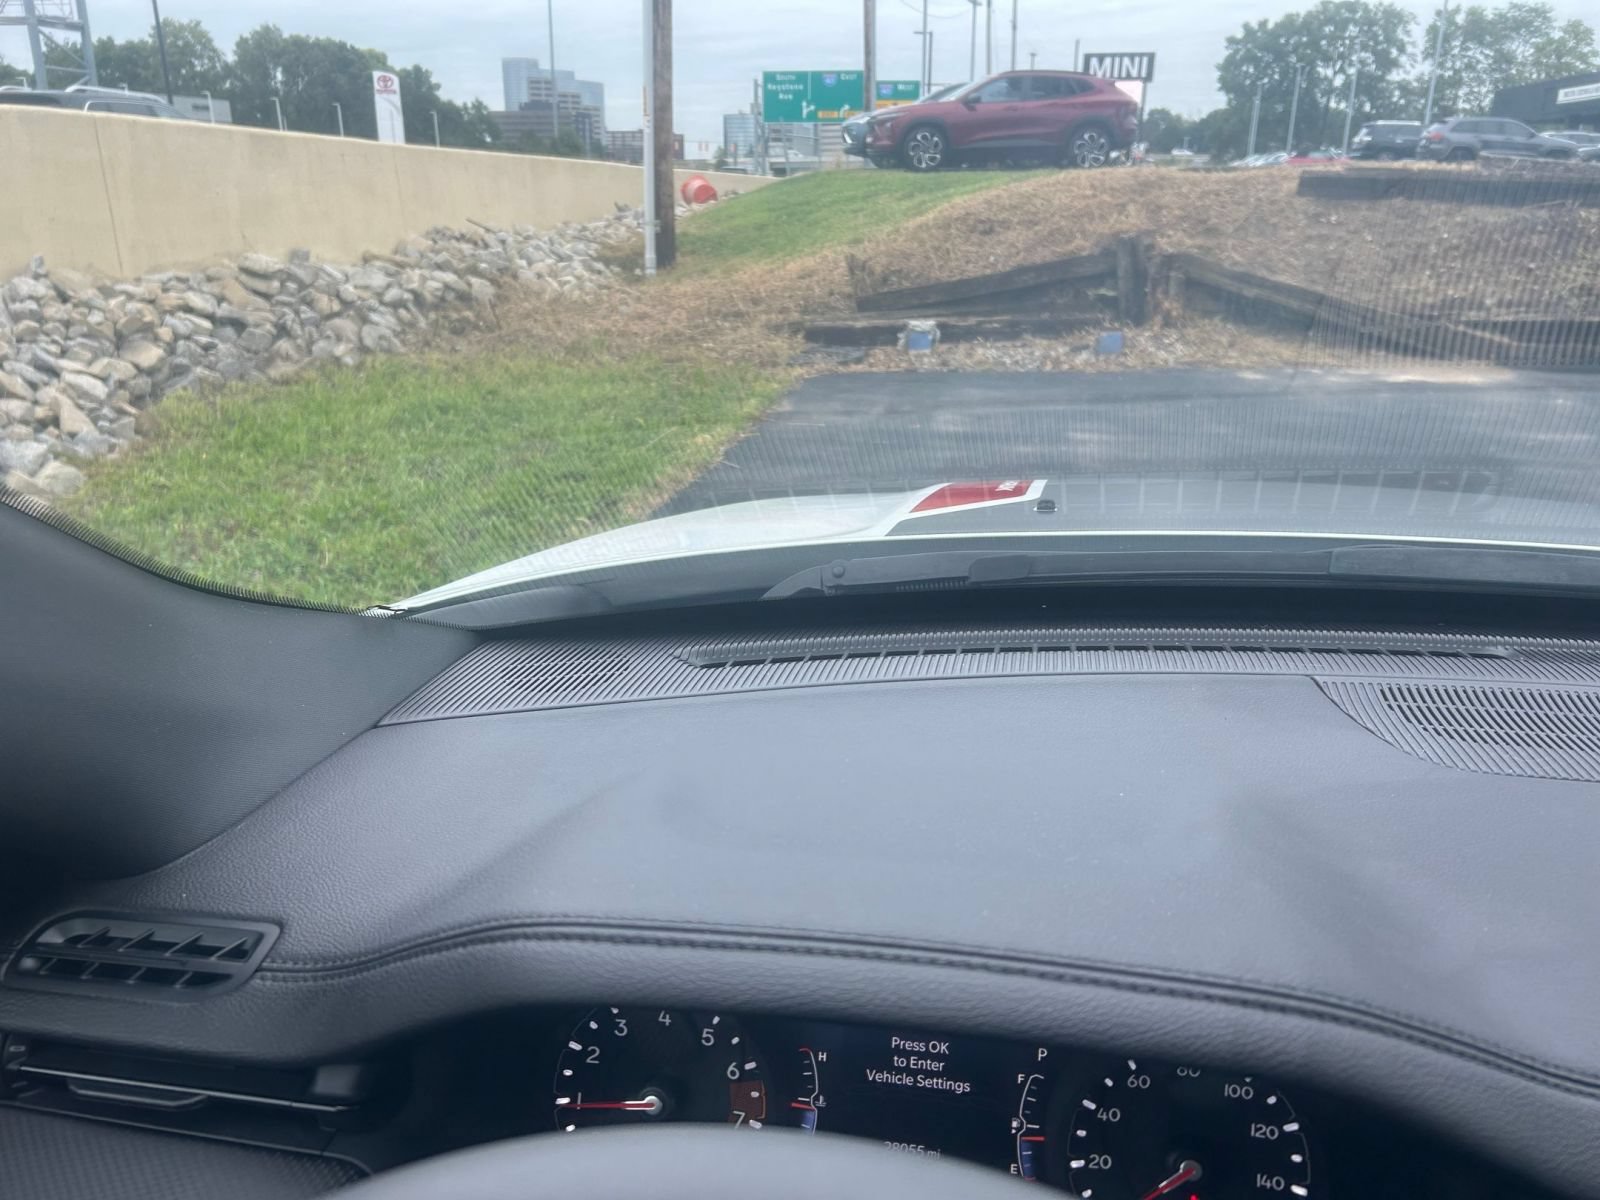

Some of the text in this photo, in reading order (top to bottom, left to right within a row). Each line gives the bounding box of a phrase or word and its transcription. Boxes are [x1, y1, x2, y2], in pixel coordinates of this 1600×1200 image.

[1089, 56, 1149, 78] MINI
[658, 1010, 672, 1027] 4
[614, 1019, 628, 1036] 3
[701, 1028, 715, 1046] 5
[891, 1036, 950, 1055] Press OK
[585, 1046, 600, 1064] 2
[818, 1052, 827, 1062] H
[1038, 1048, 1048, 1062] P
[727, 1062, 740, 1080] 6
[893, 1056, 945, 1072] to Enter
[866, 1069, 971, 1094] Vehicle Settings
[1017, 1073, 1026, 1084] F
[1127, 1074, 1151, 1089] 60
[1224, 1084, 1254, 1100] 100
[733, 1110, 746, 1129] 7
[1097, 1108, 1121, 1122] 40
[1250, 1123, 1279, 1140] 120
[1010, 1164, 1018, 1175] E
[1088, 1154, 1112, 1169] 20
[1256, 1174, 1285, 1191] 140
